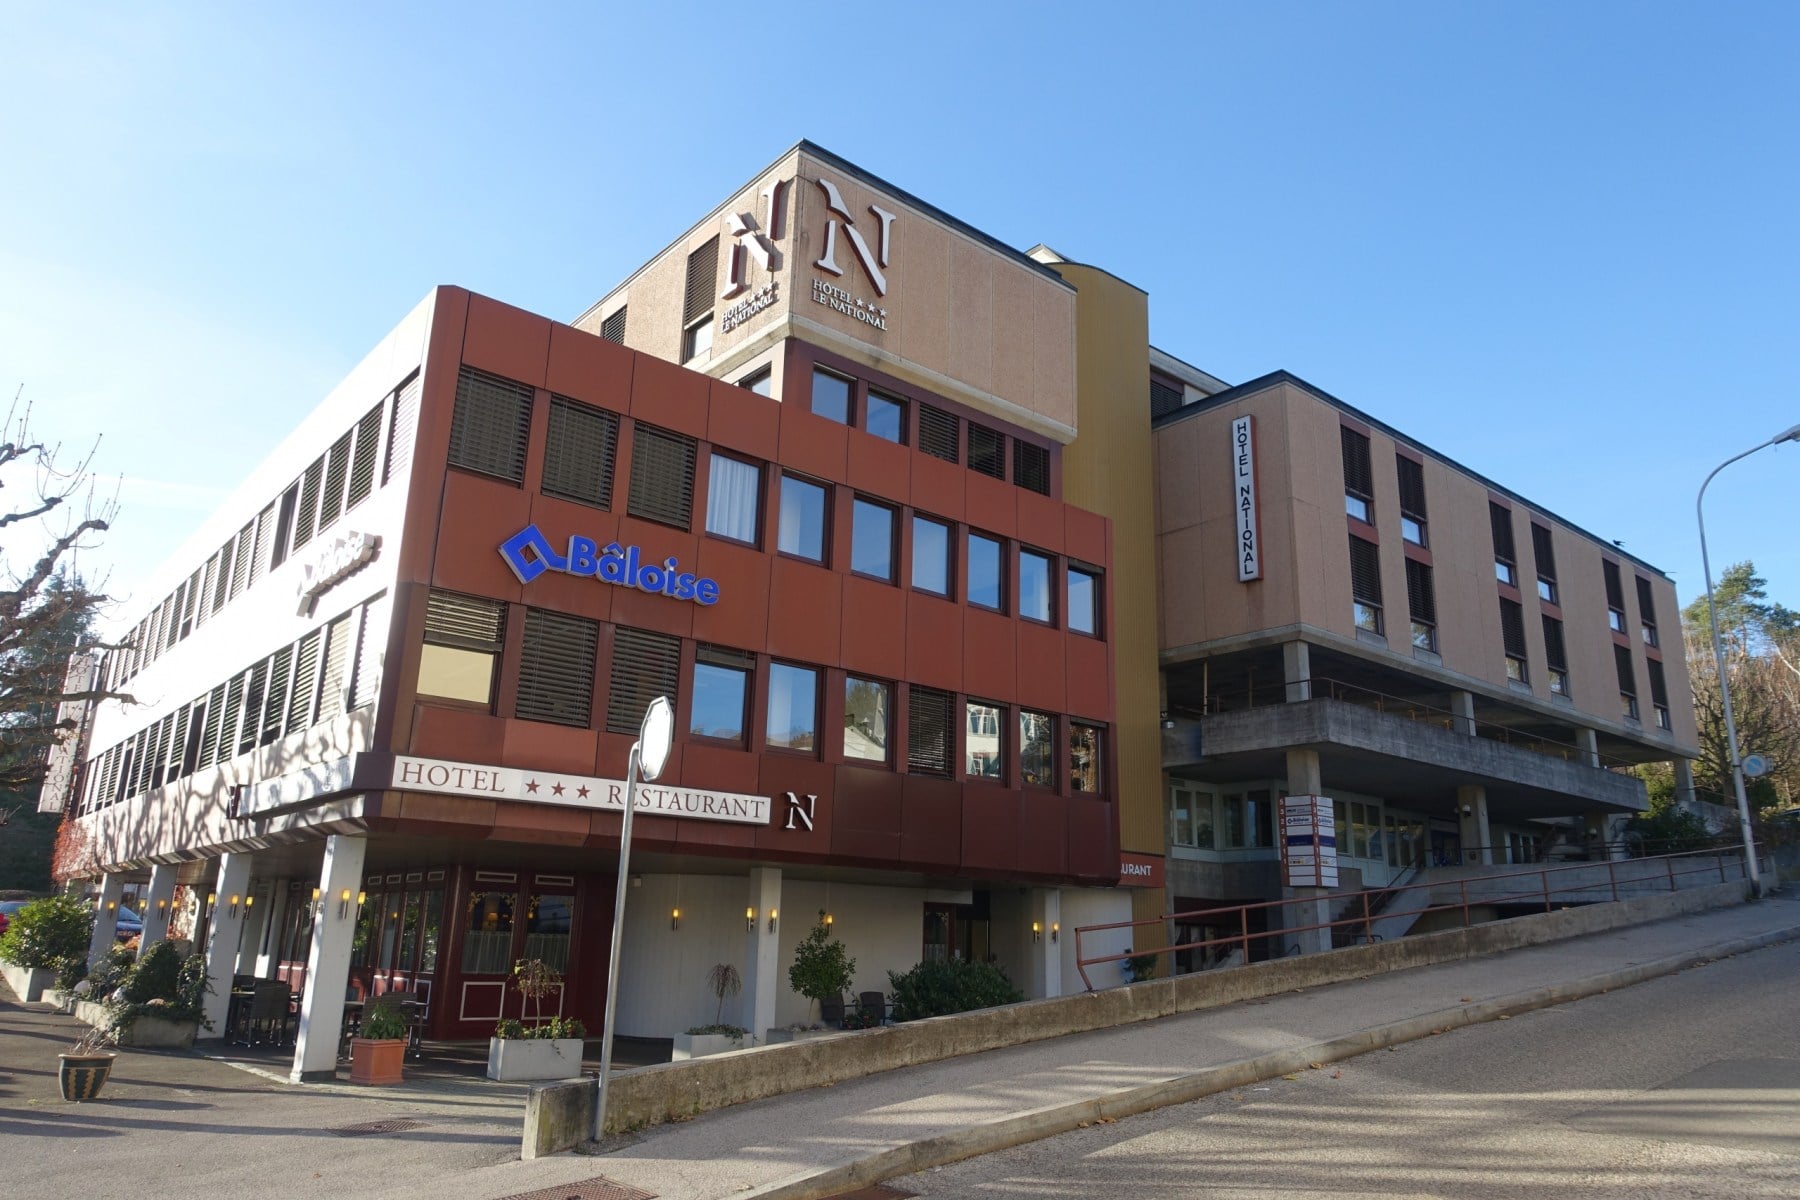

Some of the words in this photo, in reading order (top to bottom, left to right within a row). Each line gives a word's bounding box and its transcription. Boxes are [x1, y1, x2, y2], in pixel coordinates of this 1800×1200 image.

[720, 179, 784, 300] N
[813, 178, 896, 298] N
[731, 293, 775, 327] NATIONAL
[812, 290, 827, 305] LE
[828, 298, 887, 331] NATIONAL
[1237, 421, 1249, 477] HOTEL
[1240, 484, 1254, 575] NATIONAL
[566, 534, 721, 606] Bâloise
[400, 761, 505, 793] HOTEL
[785, 791, 818, 832] N
